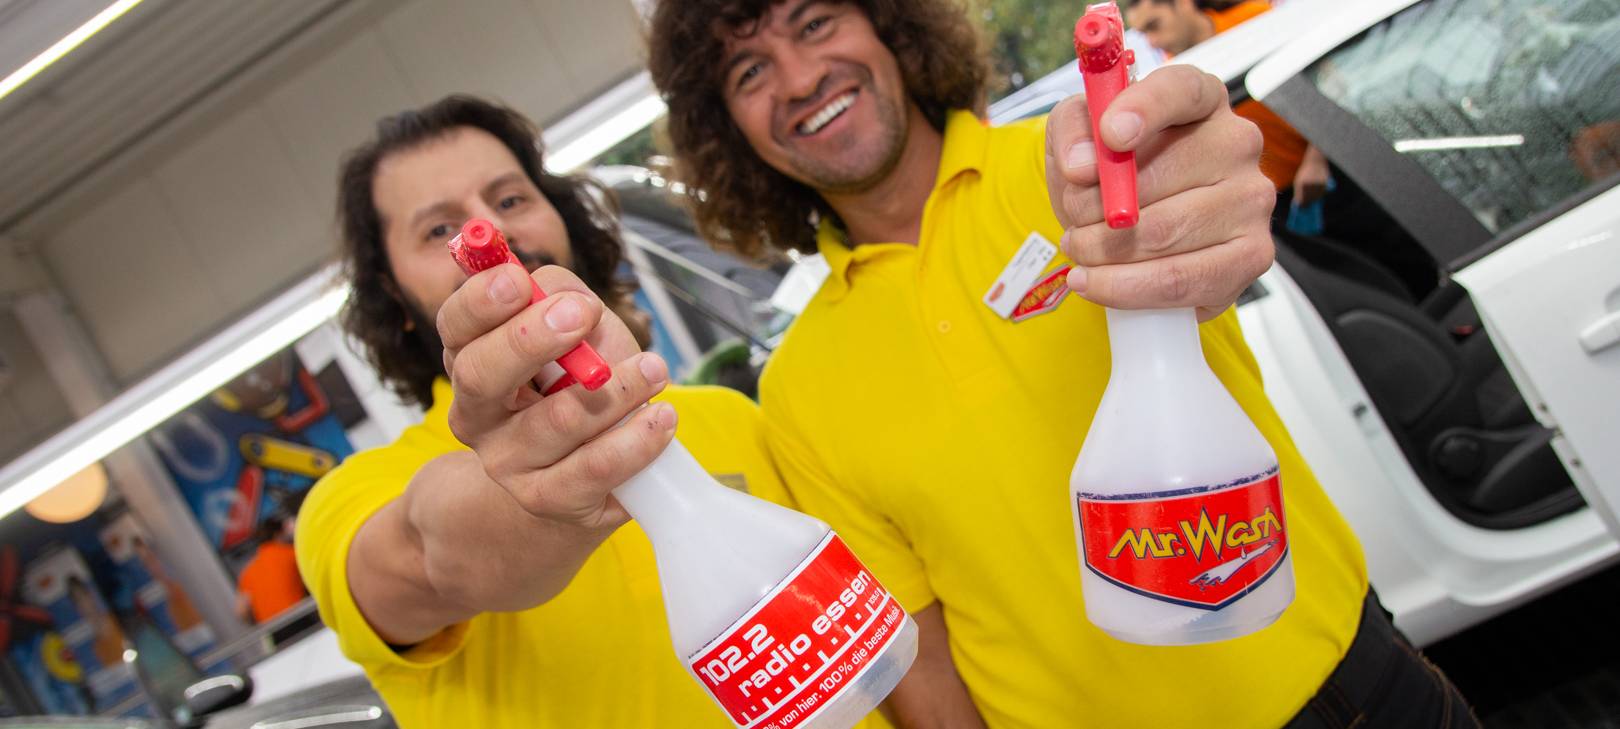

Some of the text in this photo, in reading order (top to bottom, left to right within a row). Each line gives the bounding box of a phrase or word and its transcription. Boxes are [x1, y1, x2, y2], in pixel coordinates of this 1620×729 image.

[700, 623, 775, 686] 102.2
[738, 570, 871, 698] radio essen
[779, 709, 799, 726] von
[796, 692, 822, 713] hier.
[819, 662, 853, 693] 100%
[851, 646, 867, 666] die
[866, 624, 889, 652] beste
